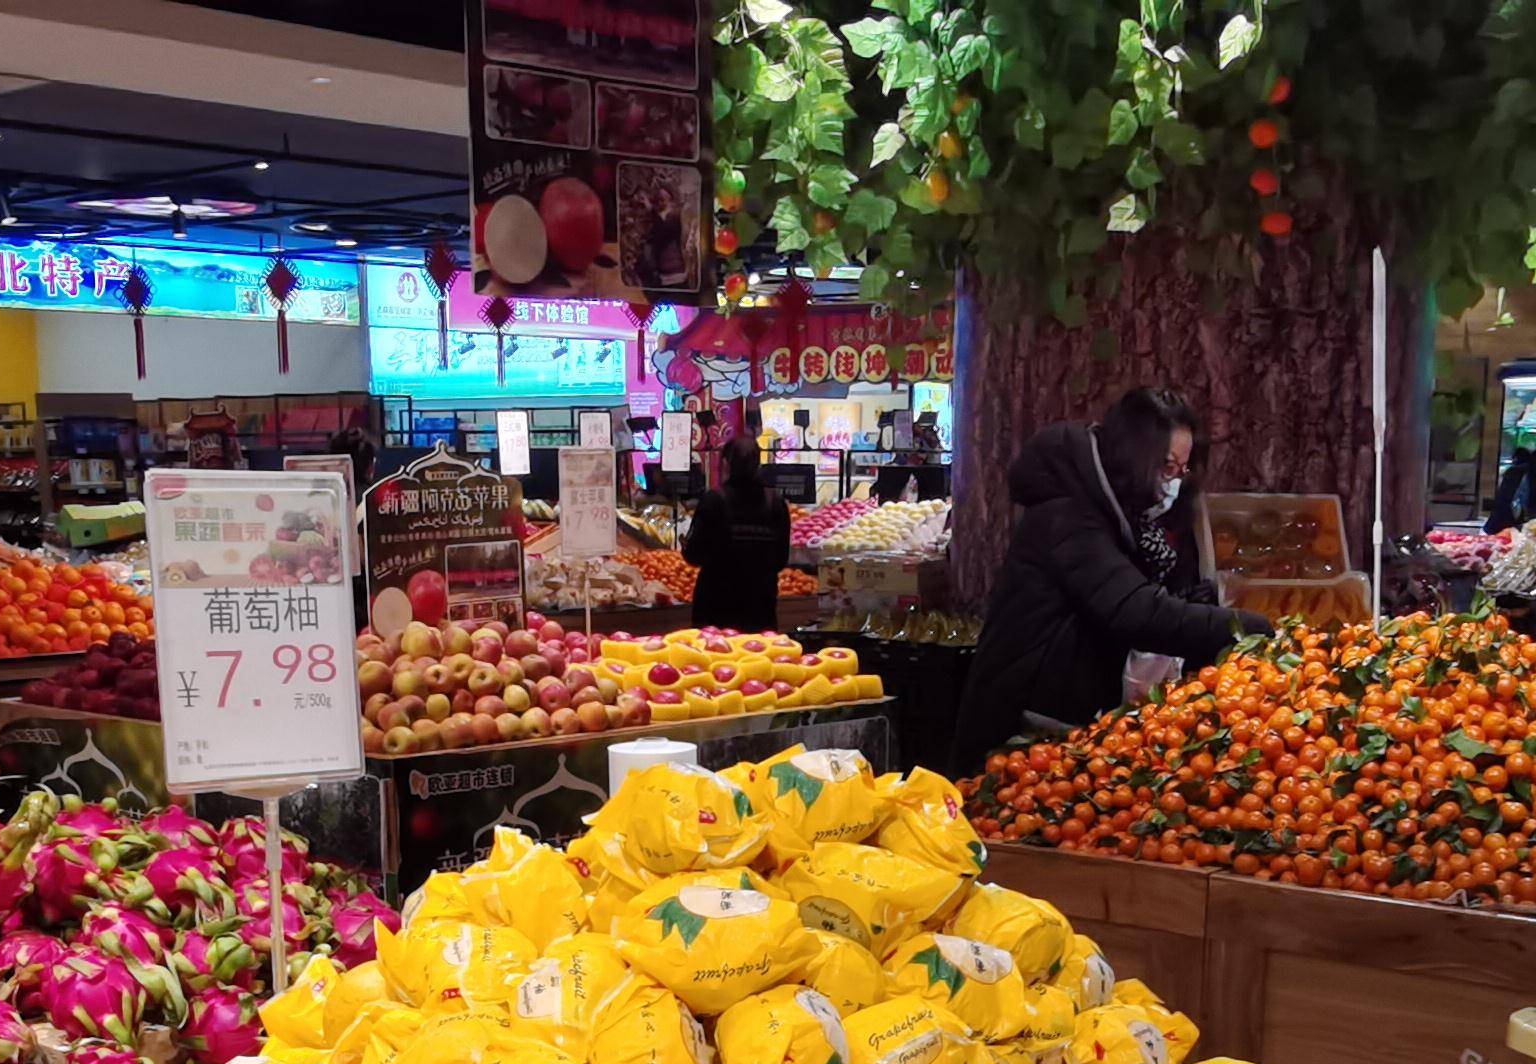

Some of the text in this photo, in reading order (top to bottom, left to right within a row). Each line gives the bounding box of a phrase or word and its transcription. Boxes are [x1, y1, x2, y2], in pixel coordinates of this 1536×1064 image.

[202, 586, 321, 635] 葡萄柚
[205, 642, 338, 709] 7.98
